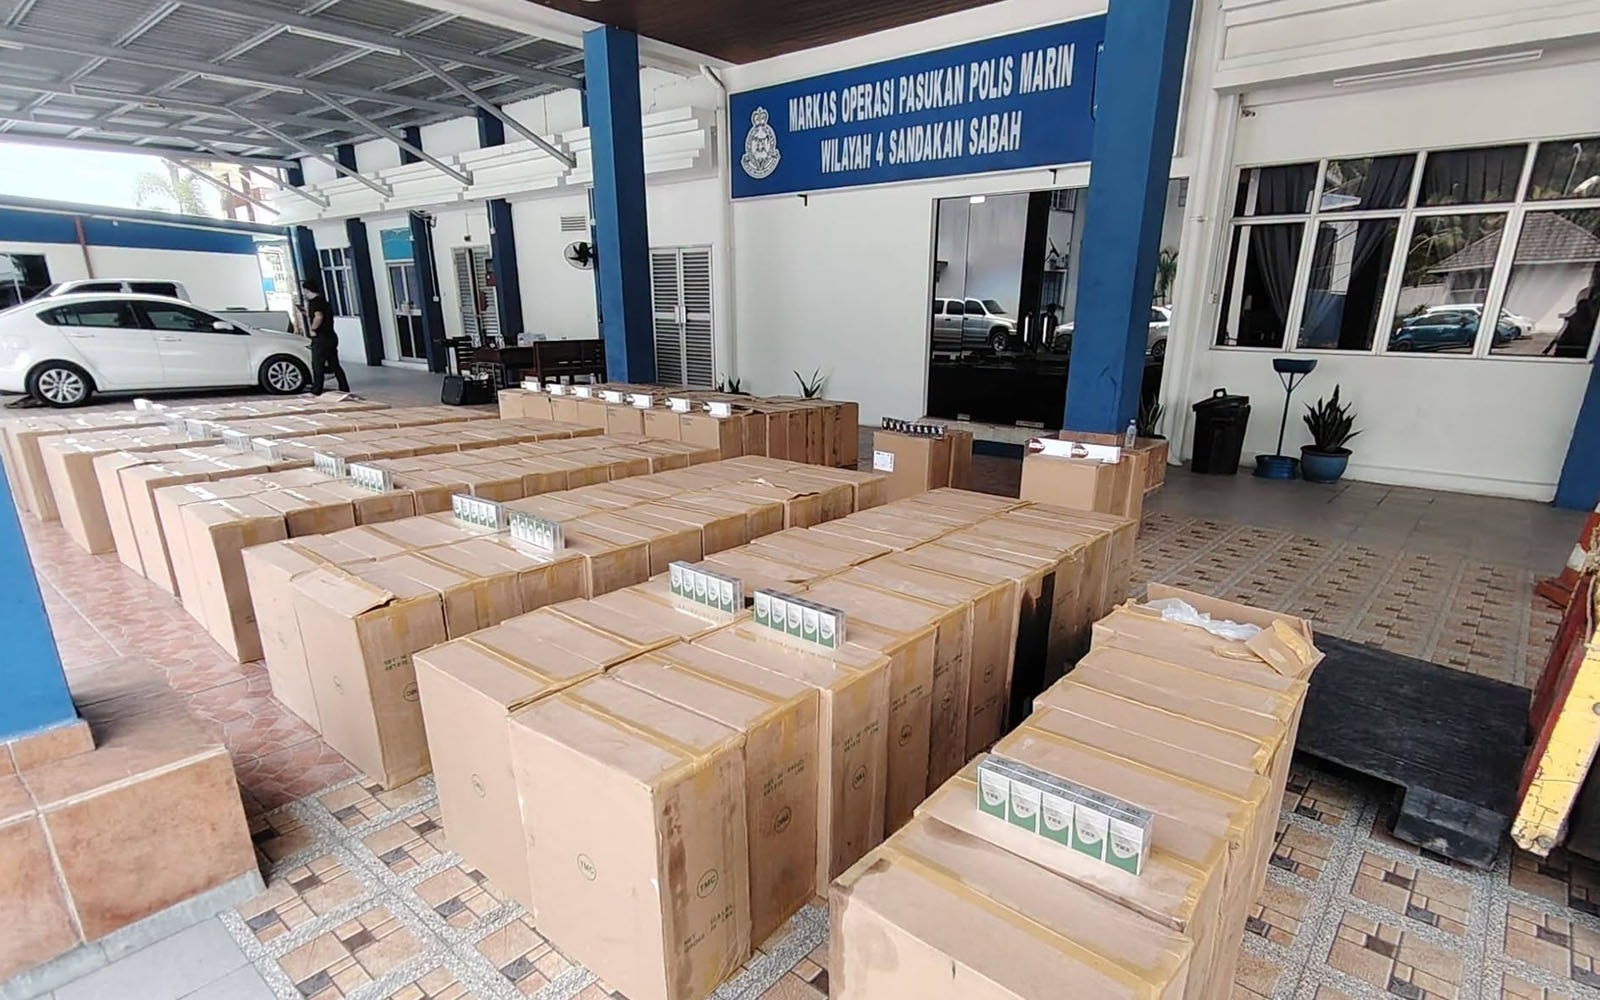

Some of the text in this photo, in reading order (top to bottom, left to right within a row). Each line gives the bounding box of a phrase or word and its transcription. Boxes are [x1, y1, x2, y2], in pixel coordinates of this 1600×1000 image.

[789, 44, 1075, 132] MARKAS OPERASI PASUKAN POLIS MARIN
[821, 110, 1022, 173] WILAYAH 4 SANDAKAN SABAH
